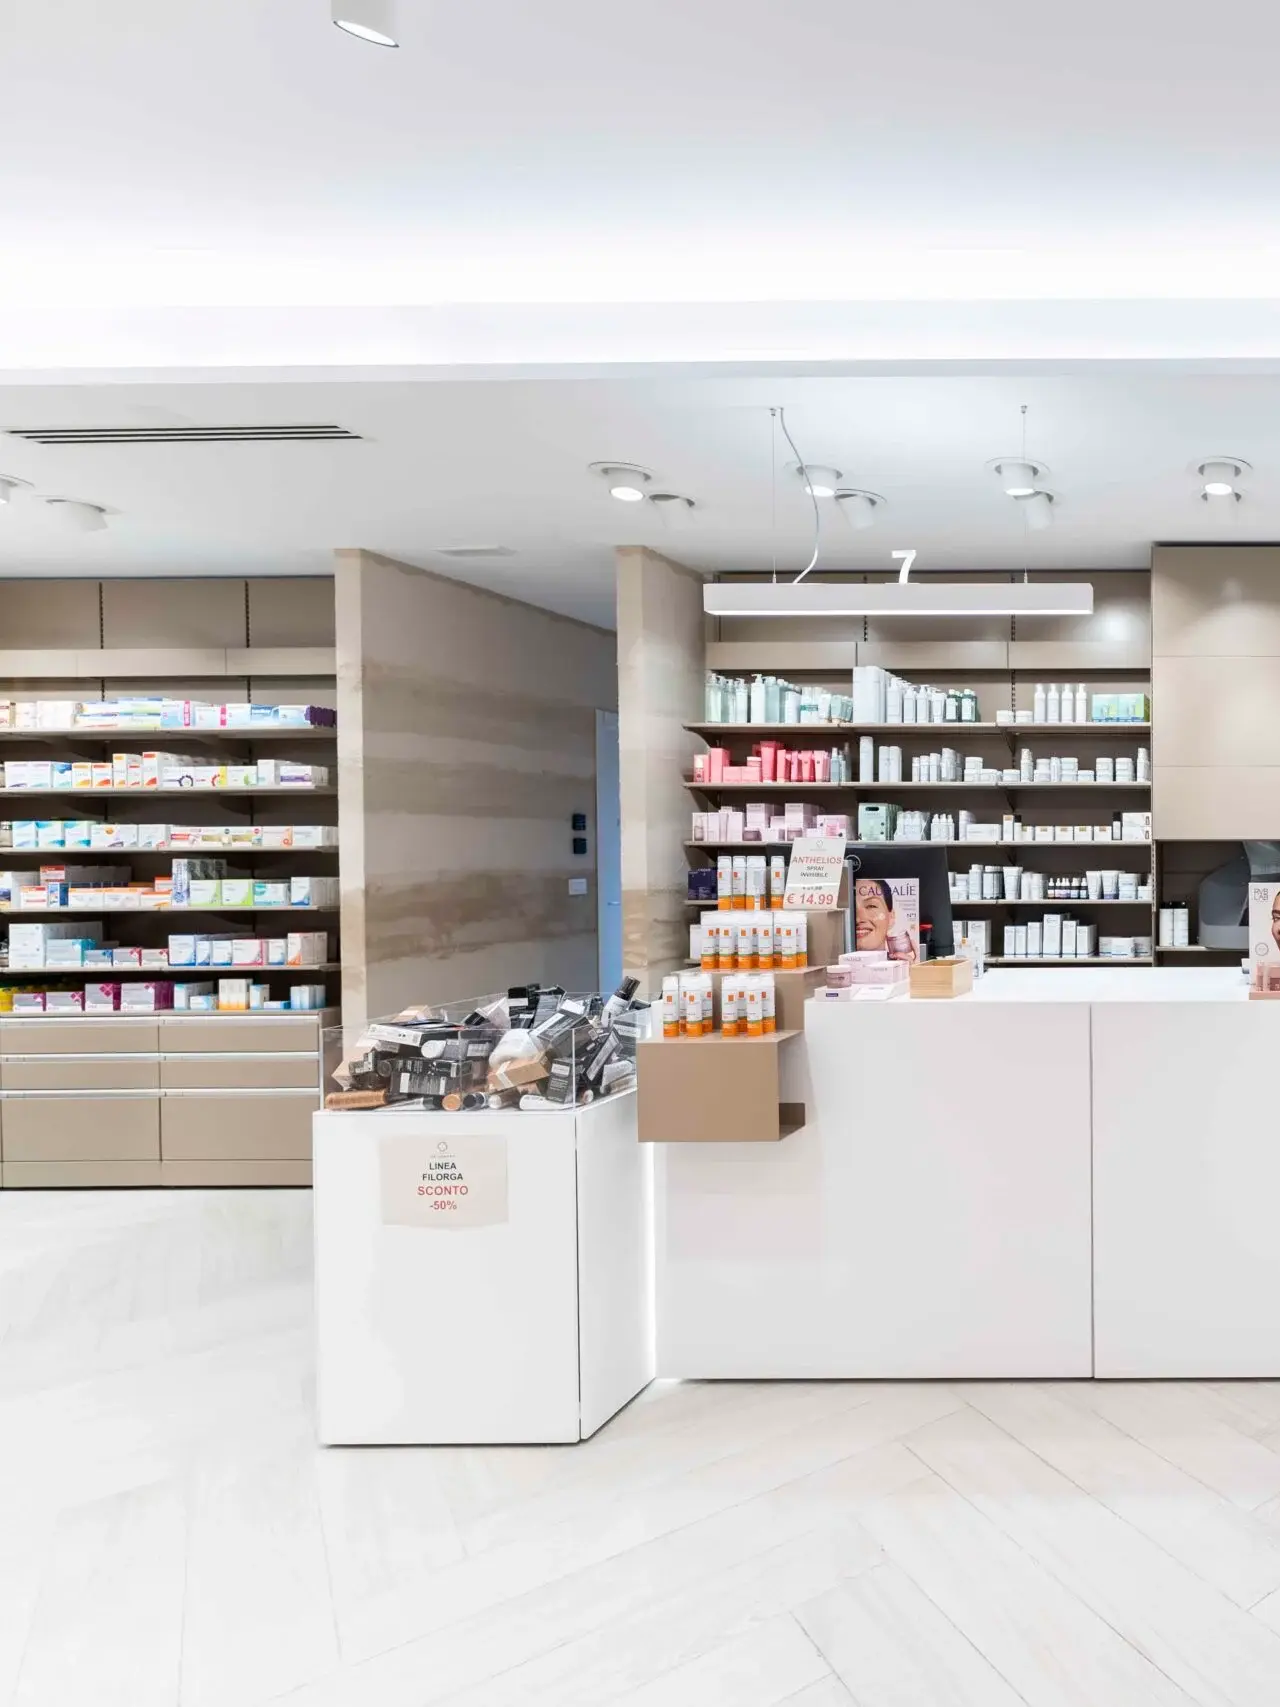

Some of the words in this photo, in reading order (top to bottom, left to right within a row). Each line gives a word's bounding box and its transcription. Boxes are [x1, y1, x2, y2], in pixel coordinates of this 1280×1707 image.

[891, 550, 917, 584] 7
[791, 856, 842, 865] ANTHELIOS
[858, 882, 917, 896] CAUALÍE
[786, 893, 796, 904] €
[800, 894, 834, 905] 14.99
[429, 1162, 457, 1170] LINEA
[422, 1173, 464, 1181] FILORGA
[417, 1185, 469, 1196] SCONTO
[429, 1200, 457, 1210] -50%
